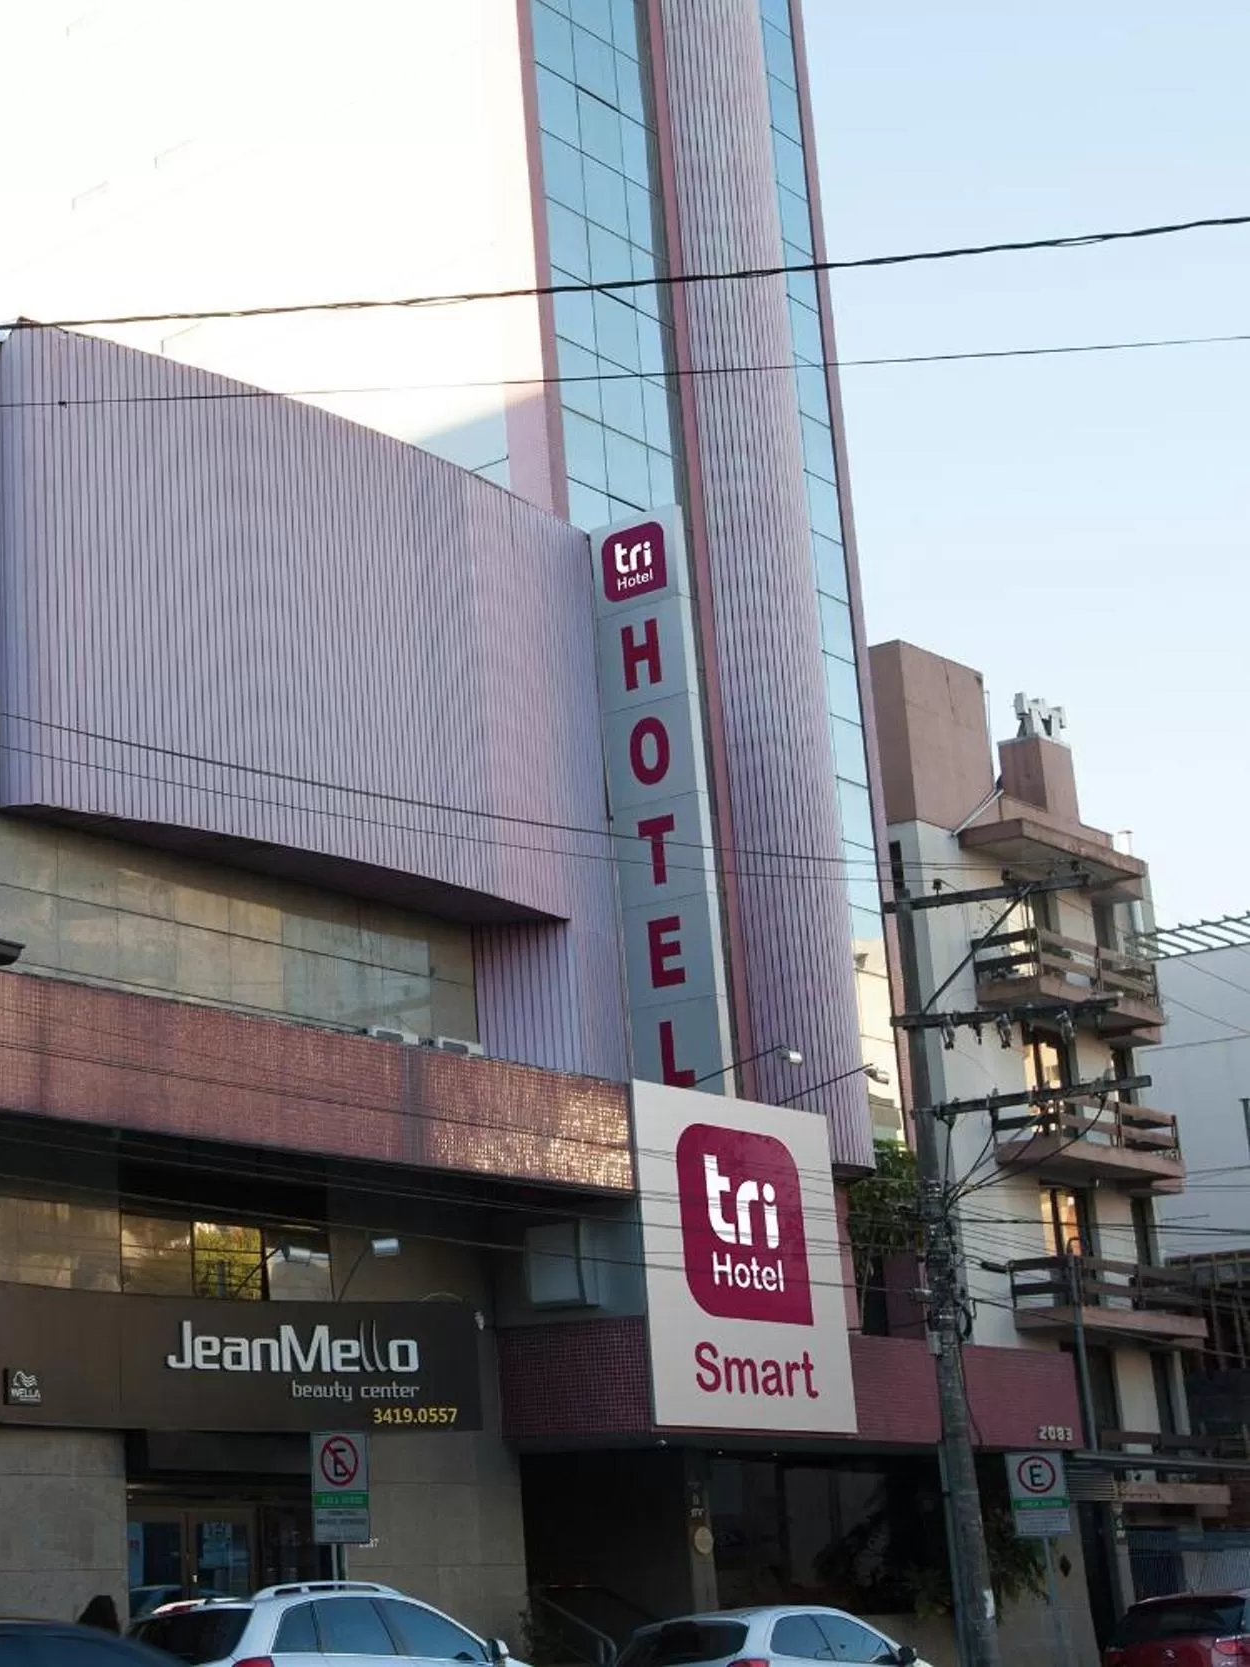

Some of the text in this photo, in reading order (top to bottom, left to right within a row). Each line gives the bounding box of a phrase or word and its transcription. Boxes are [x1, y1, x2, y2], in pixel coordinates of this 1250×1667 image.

[614, 538, 653, 575] tri
[617, 568, 654, 591] Hotel
[621, 617, 696, 1088] HOTEL
[703, 1154, 780, 1249] tri
[713, 1252, 785, 1292] Hotel
[167, 1320, 420, 1372] JeanMello
[695, 1342, 820, 1399] Smart
[11, 1387, 42, 1399] WELLA
[292, 1379, 420, 1401] beauty center
[372, 1407, 458, 1424] 3419.0557
[1028, 1464, 1045, 1487] E
